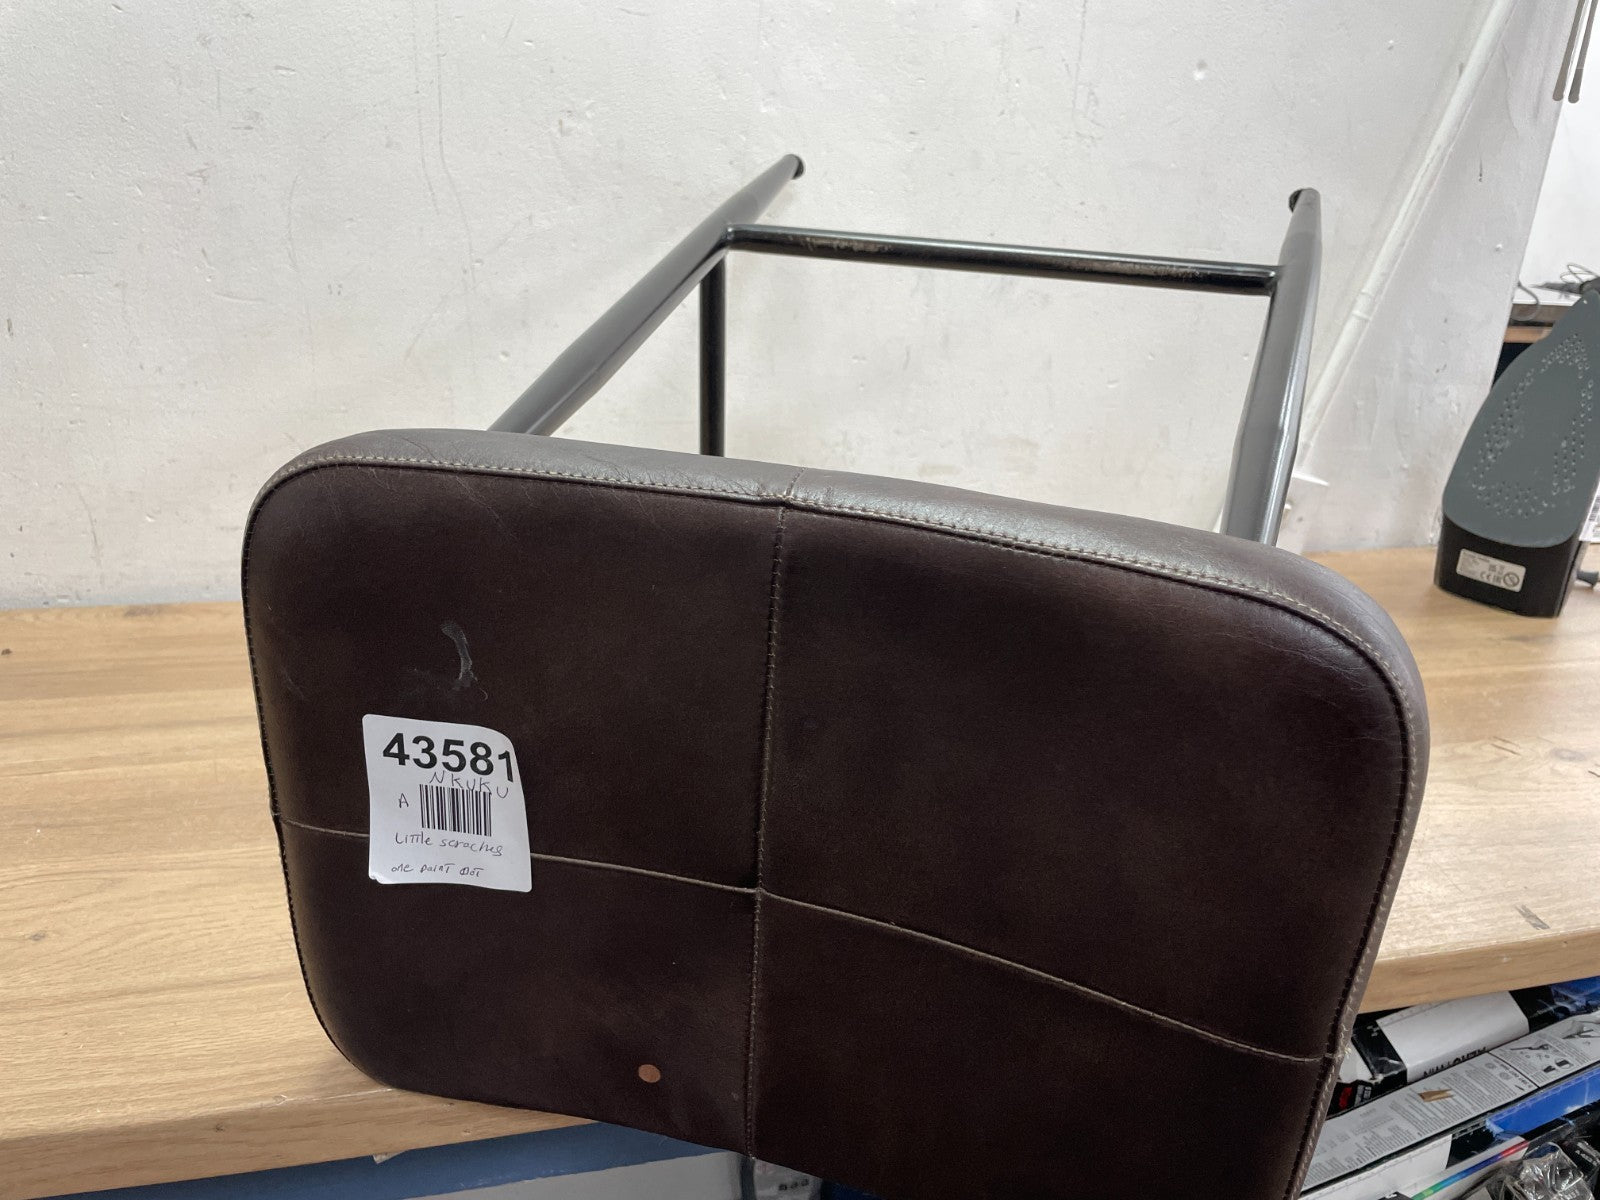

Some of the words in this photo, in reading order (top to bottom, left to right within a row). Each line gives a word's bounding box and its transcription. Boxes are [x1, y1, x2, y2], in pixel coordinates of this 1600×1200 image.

[383, 733, 513, 782] 43581
[429, 771, 509, 798] NKUKU
[398, 793, 409, 808] A
